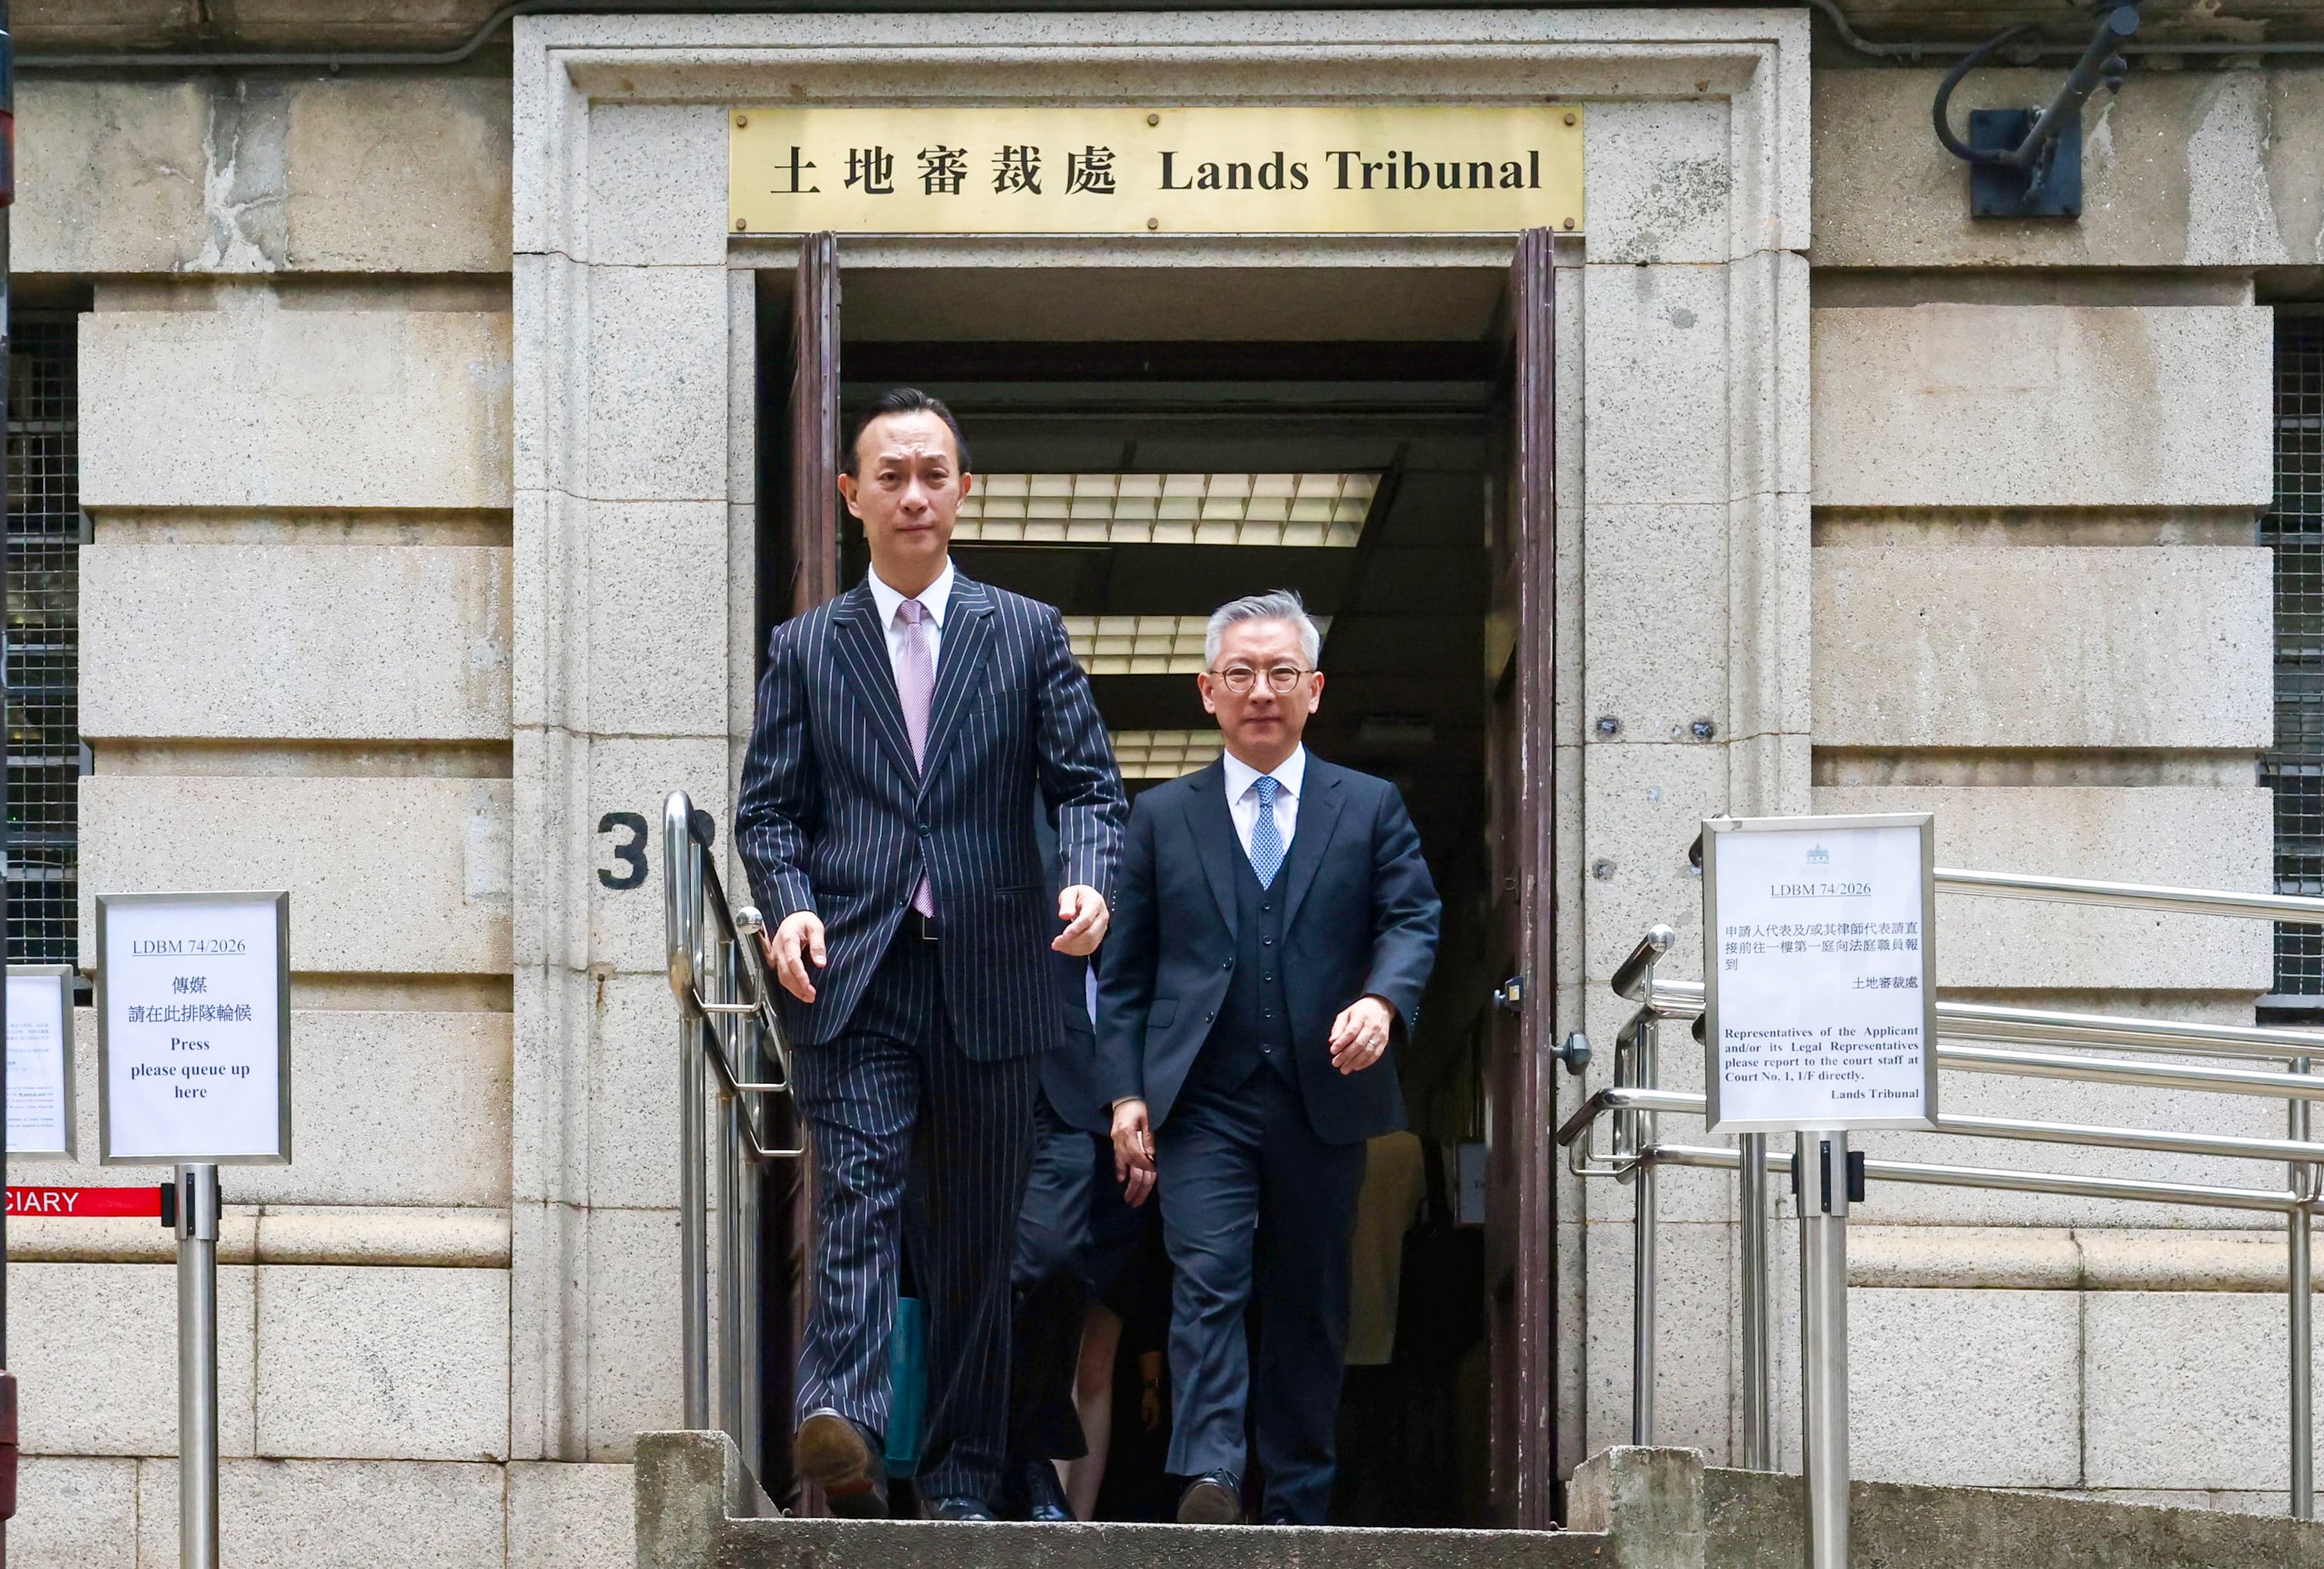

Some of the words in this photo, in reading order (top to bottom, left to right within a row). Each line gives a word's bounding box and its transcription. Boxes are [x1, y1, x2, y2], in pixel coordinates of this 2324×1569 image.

[770, 144, 1116, 196] 土地審裁處
[1157, 151, 1309, 190] Lands
[1325, 150, 1542, 190] Tribunal
[596, 810, 650, 892] 3
[1771, 884, 1814, 896] LDBM
[1820, 883, 1872, 896] 74/2026
[1725, 921, 1918, 938] 申請人代表及/或其律師代表請直
[133, 940, 182, 954] LDBM
[188, 938, 246, 953] 74/2026
[1725, 938, 1918, 954] 接前往一樓第一庭向法庭職員報
[1725, 958, 1738, 971] 到
[172, 976, 207, 995] 傳媒
[1852, 976, 1919, 989] 土地審裁處
[128, 1003, 252, 1023] 請在此排隊輪候
[1725, 1027, 1813, 1040] Representatives
[1820, 1027, 1833, 1037] of
[1839, 1027, 1856, 1037] the
[1863, 1026, 1918, 1039] Applicant
[171, 1037, 210, 1051] Press
[1725, 1043, 1762, 1053] and/or
[1769, 1042, 1783, 1053] its
[1792, 1041, 1822, 1053] Legal
[1830, 1040, 1919, 1053] Representatives
[1725, 1057, 1759, 1070] please
[1764, 1058, 1799, 1069] report
[1805, 1058, 1815, 1066] to
[1821, 1056, 1838, 1066] the
[1843, 1057, 1872, 1066] court
[1878, 1055, 1904, 1065] staff
[1907, 1056, 1918, 1065] at
[131, 1063, 177, 1080] please
[181, 1066, 226, 1079] queue
[231, 1066, 250, 1079] up
[1725, 1072, 1758, 1082] Court
[1762, 1072, 1781, 1082] No.
[1785, 1072, 1794, 1082] 1,
[1798, 1071, 1815, 1081] 1/F
[1818, 1070, 1865, 1082] directly.
[174, 1085, 207, 1098] here
[1831, 1089, 1865, 1099] Lands
[1869, 1088, 1919, 1098] Tribunal
